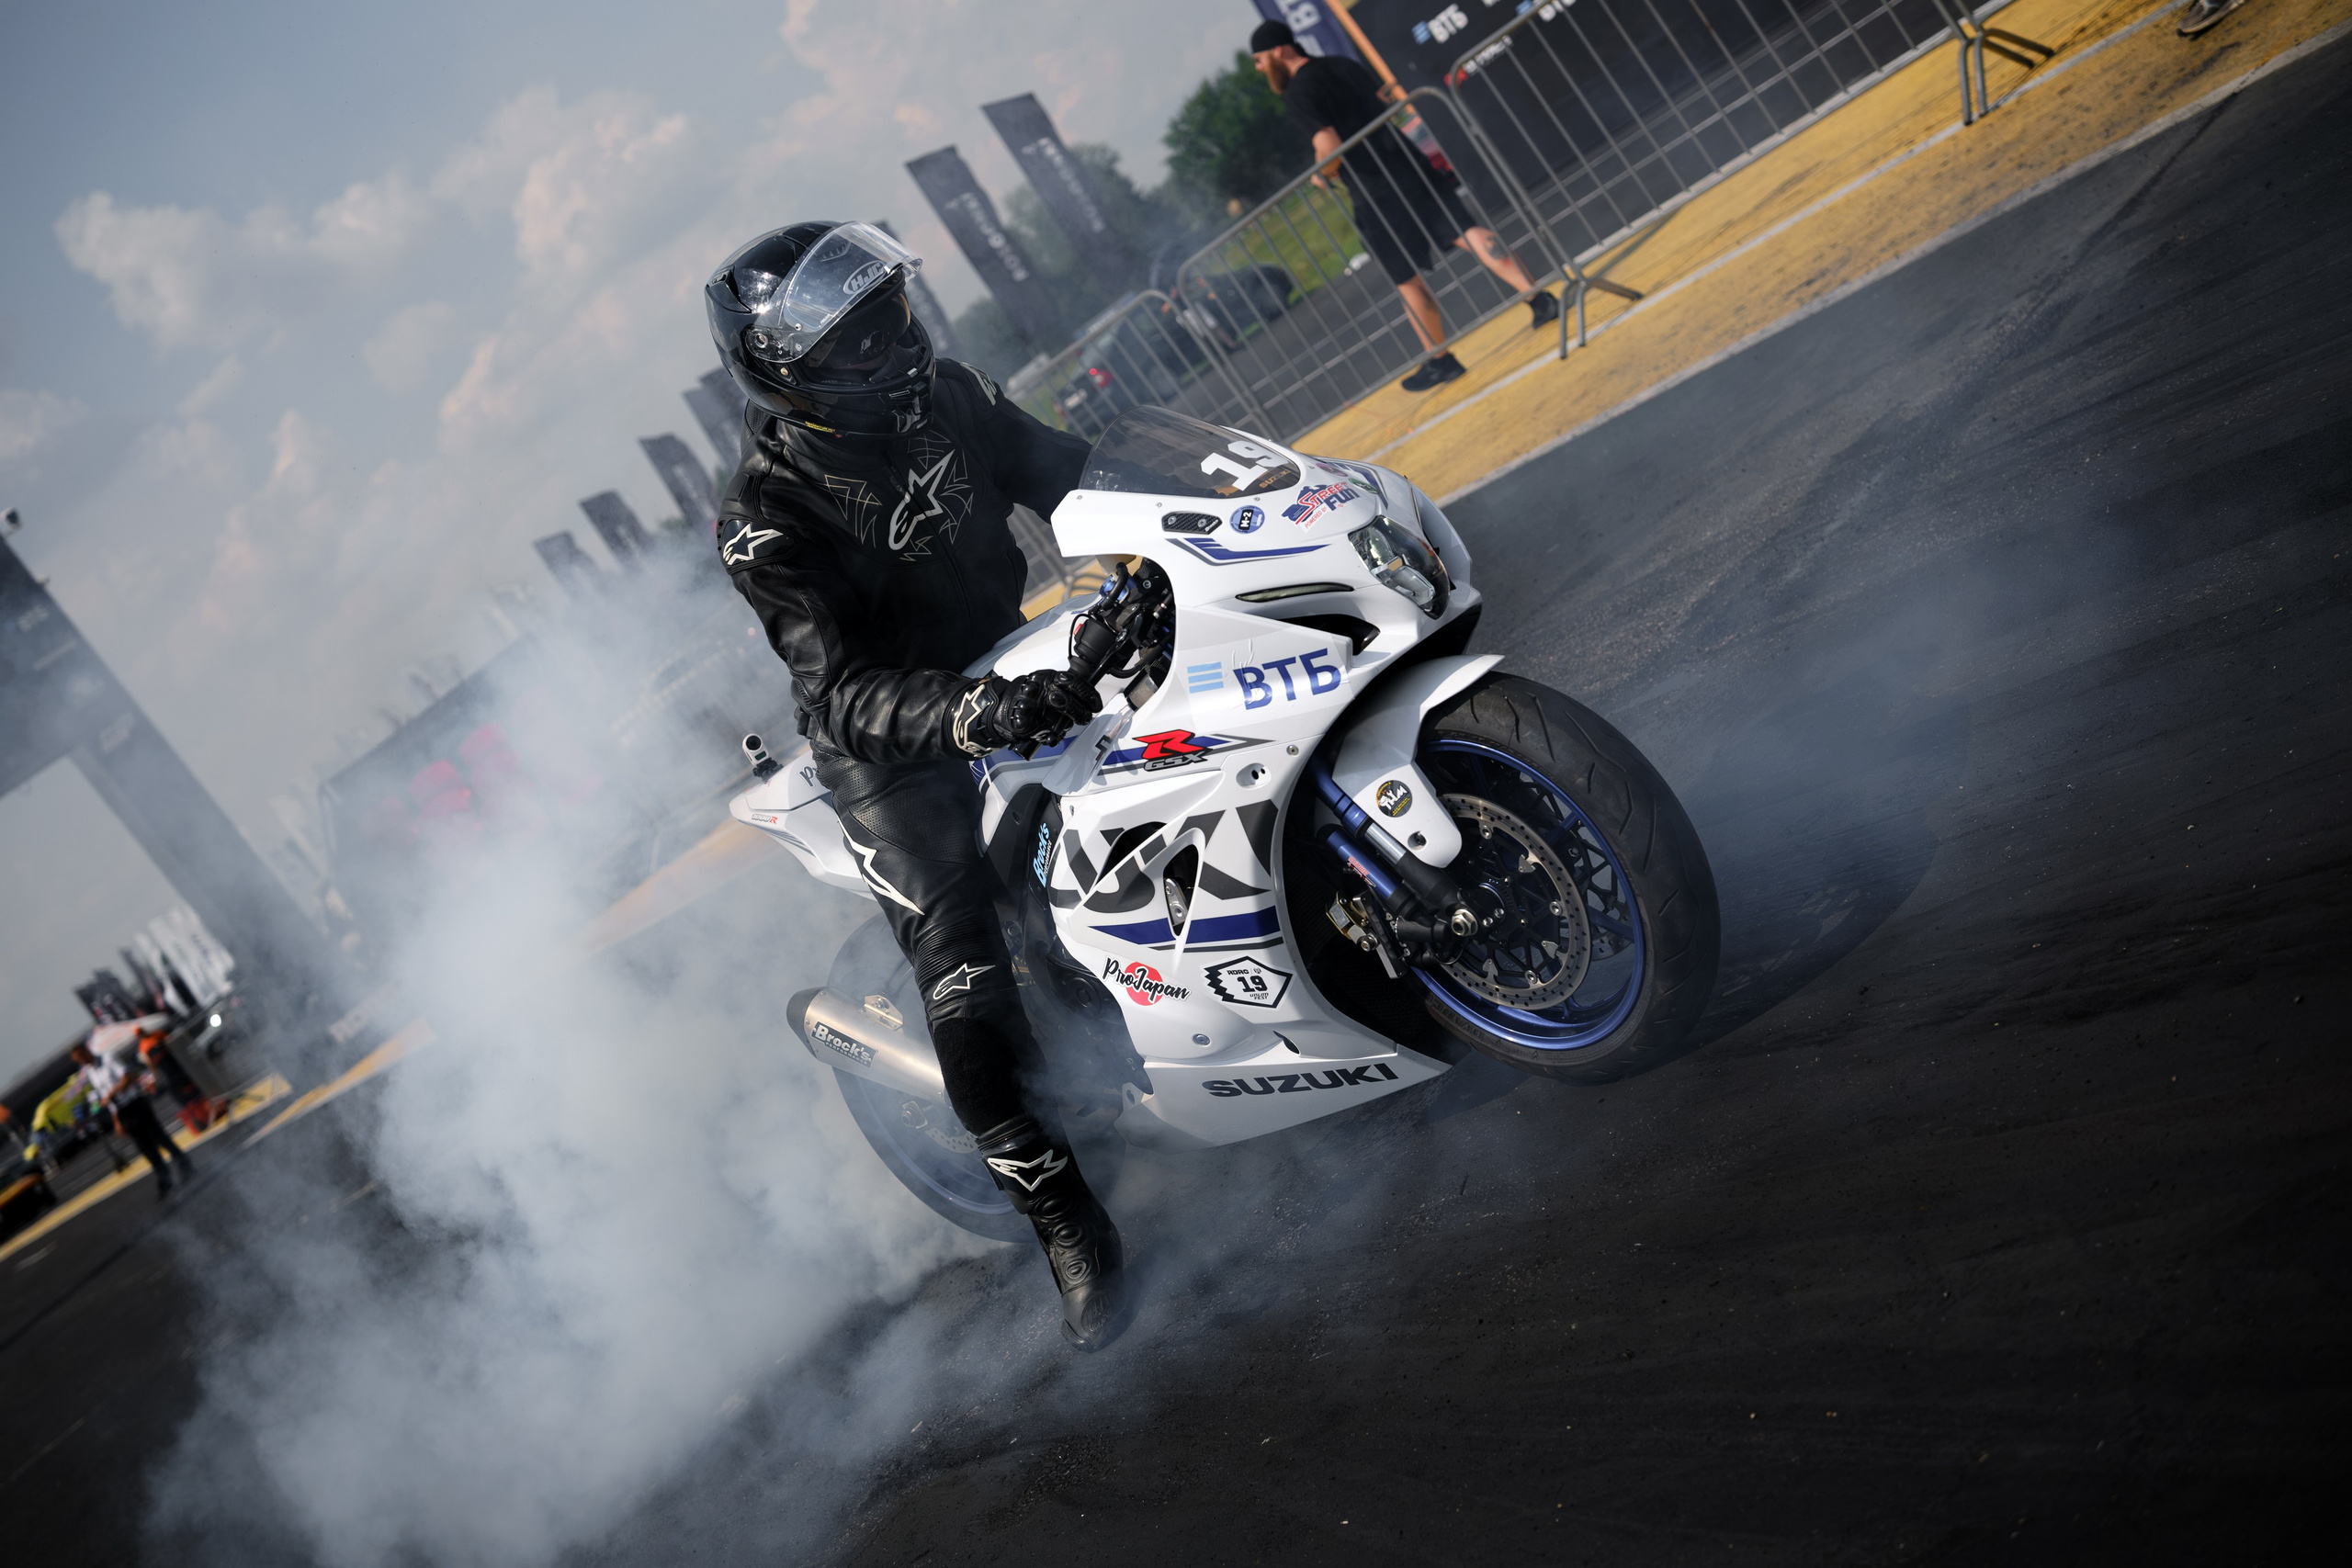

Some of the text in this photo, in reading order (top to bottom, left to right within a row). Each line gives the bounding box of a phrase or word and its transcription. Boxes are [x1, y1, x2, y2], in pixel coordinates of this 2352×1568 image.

[1428, 3, 1469, 44] ВТБ
[851, 263, 884, 291] HJC
[1200, 440, 1289, 491] 19
[1240, 512, 1252, 527] M-2
[1295, 481, 1351, 525] STREET
[1305, 510, 1323, 529] POWERED
[1232, 648, 1341, 710] ВТБ
[1144, 750, 1206, 772] GSX
[1033, 823, 1049, 888] Brock's
[1102, 957, 1191, 1002] ProJapan
[1237, 976, 1268, 993] 19
[814, 1024, 871, 1061] Brock's
[1201, 1062, 1399, 1098] SUZUKI
